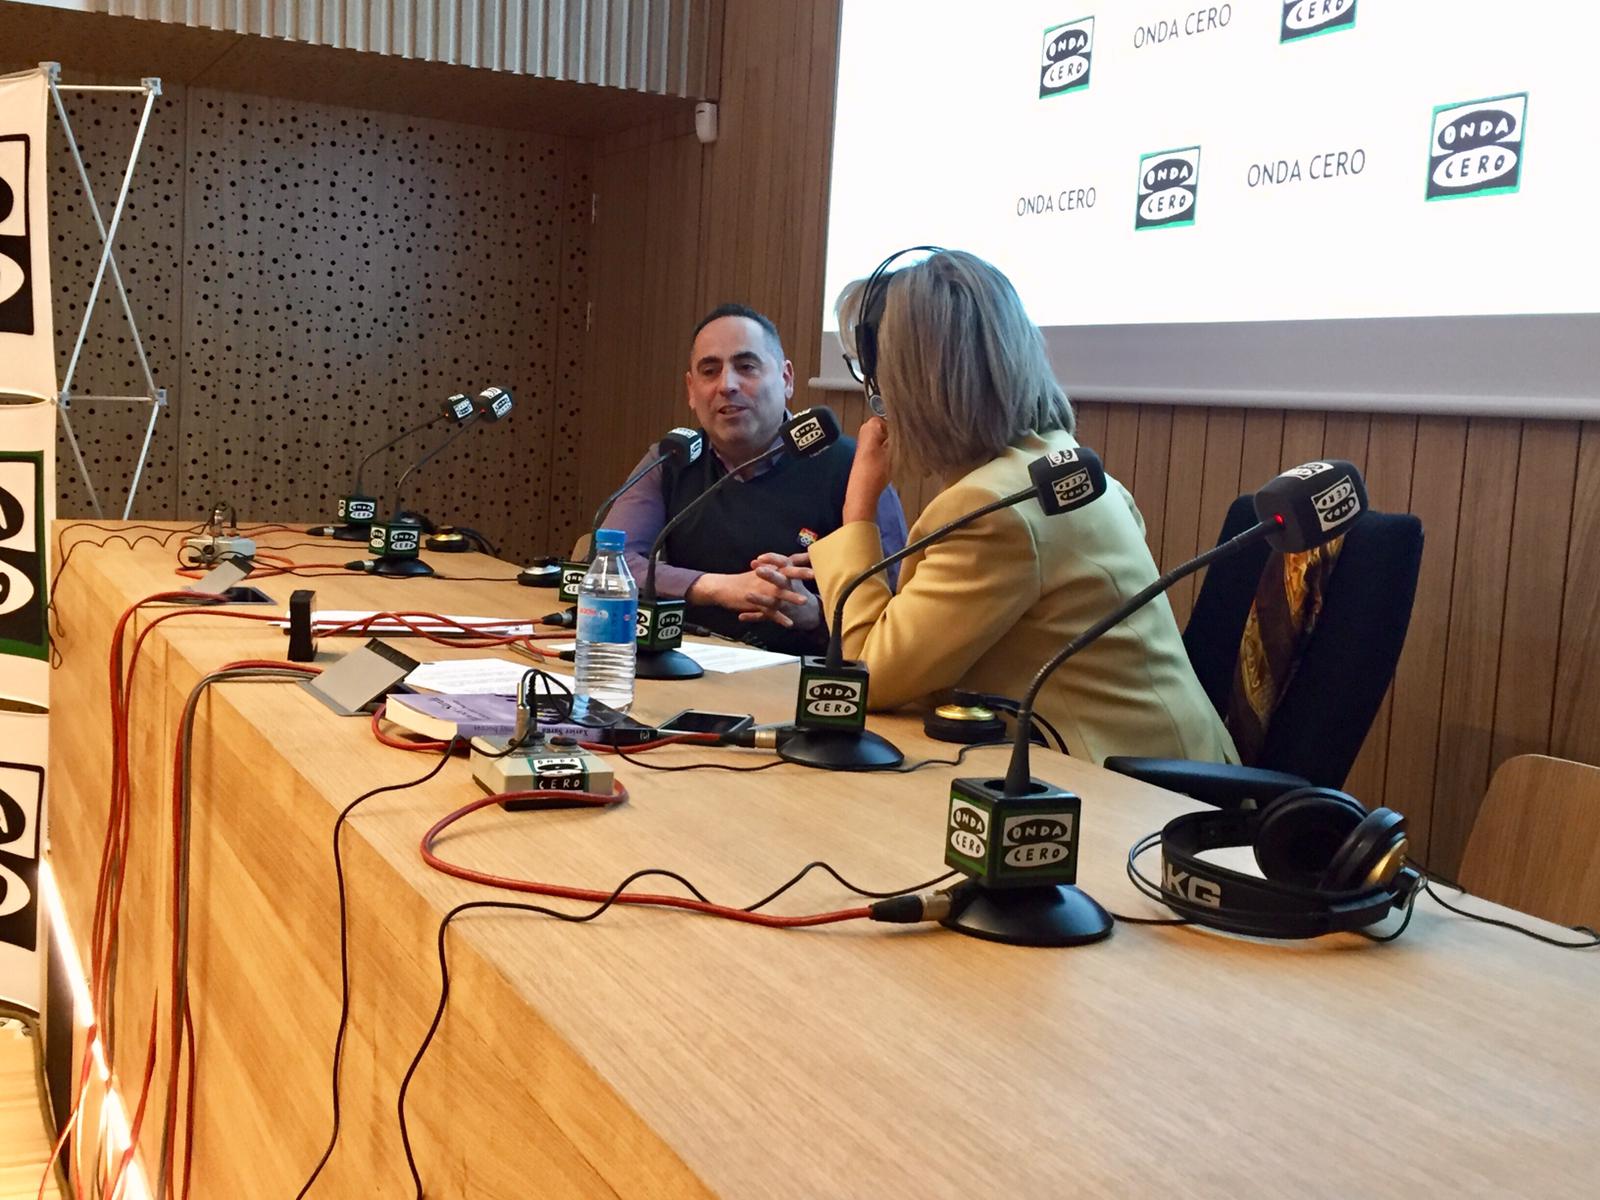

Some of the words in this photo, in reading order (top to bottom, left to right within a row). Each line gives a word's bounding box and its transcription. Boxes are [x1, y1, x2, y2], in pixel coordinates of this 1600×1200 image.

[1296, 0, 1343, 22] CERO
[1134, 19, 1178, 48] ONDA
[1185, 4, 1231, 35] CERO
[1049, 35, 1085, 57] ONDA
[1050, 62, 1083, 82] CERO
[1443, 118, 1508, 144] ONDA
[1147, 165, 1189, 185] ONDA
[1248, 160, 1302, 187] ONDA
[1309, 149, 1365, 179] CERO
[1445, 155, 1505, 179] CERO
[1017, 194, 1053, 216] ONDA
[1058, 187, 1096, 211] CERO
[1148, 194, 1187, 213] CERO
[1322, 486, 1349, 506] CERO
[1327, 499, 1355, 519] ONDA
[813, 687, 853, 697] ONDA
[814, 702, 851, 713] CERO
[539, 778, 580, 790] CERO
[955, 810, 983, 832] ONDA
[1012, 826, 1062, 839] ONDA
[956, 834, 981, 854] CERO
[1014, 848, 1060, 861] CERO
